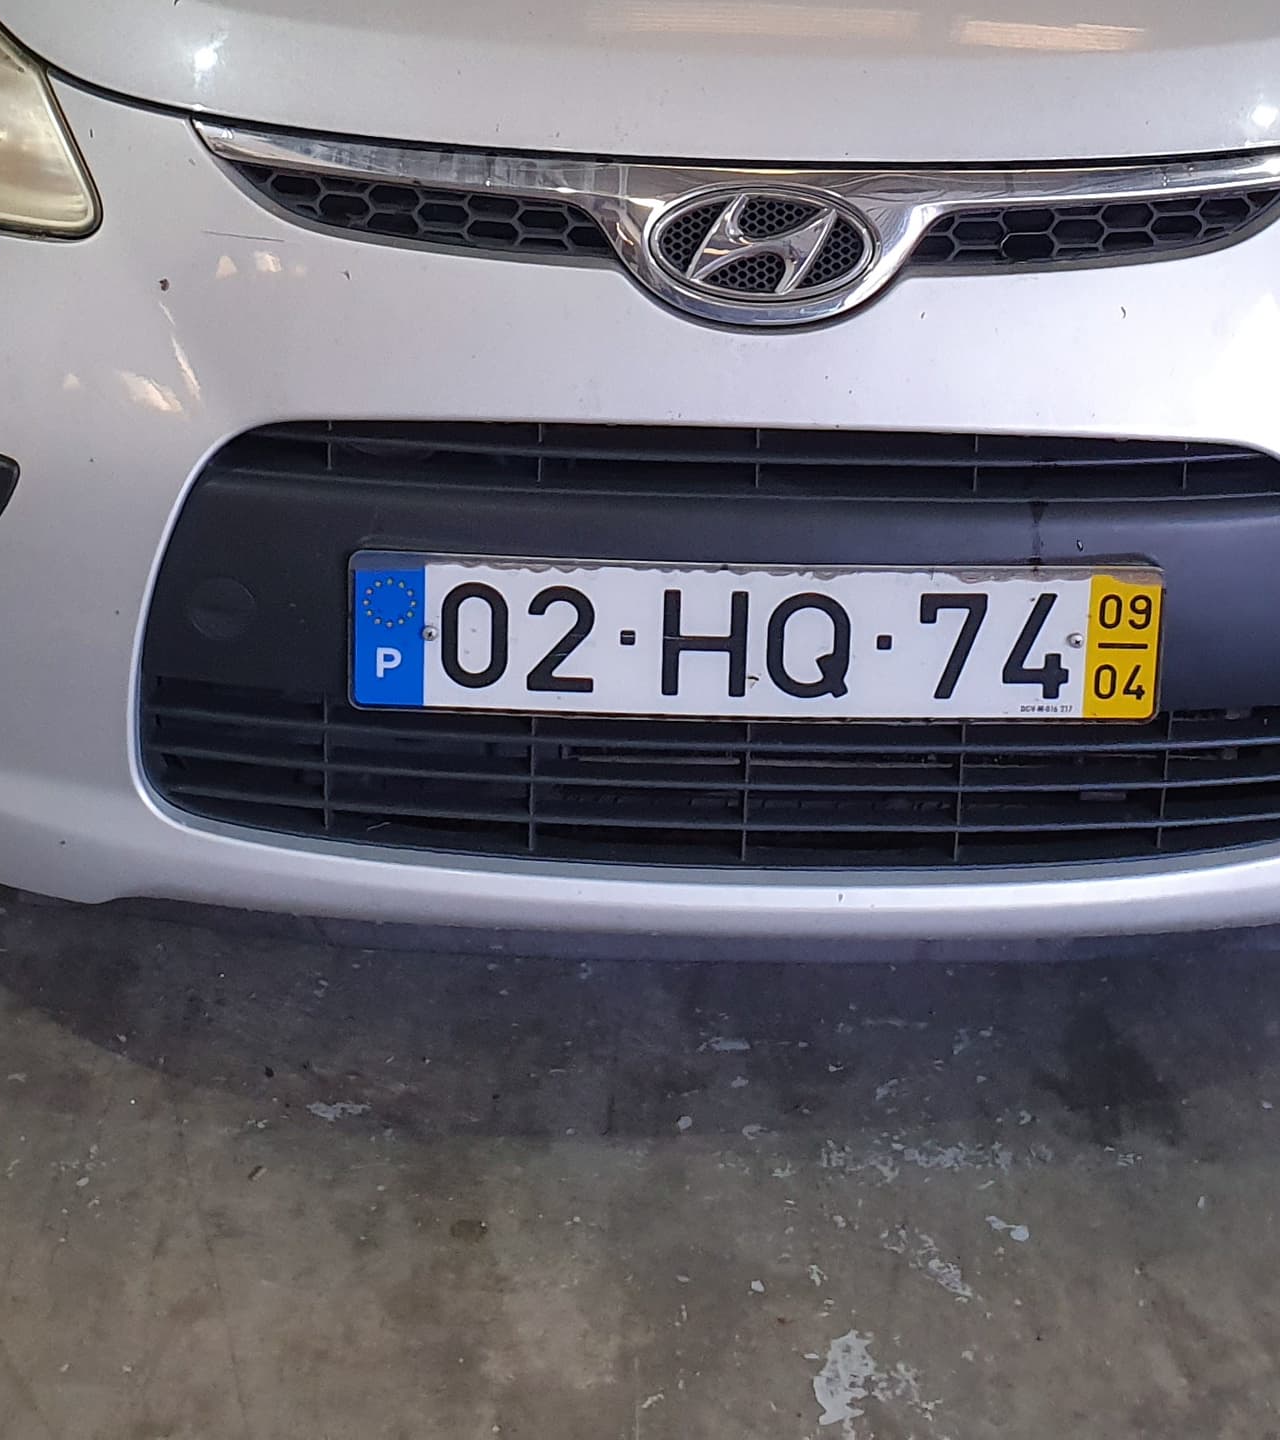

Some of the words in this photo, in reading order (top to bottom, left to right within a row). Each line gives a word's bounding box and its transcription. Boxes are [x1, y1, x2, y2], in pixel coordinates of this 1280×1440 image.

[1099, 594, 1152, 630] 09
[376, 647, 402, 678] P
[1094, 664, 1146, 700] 04
